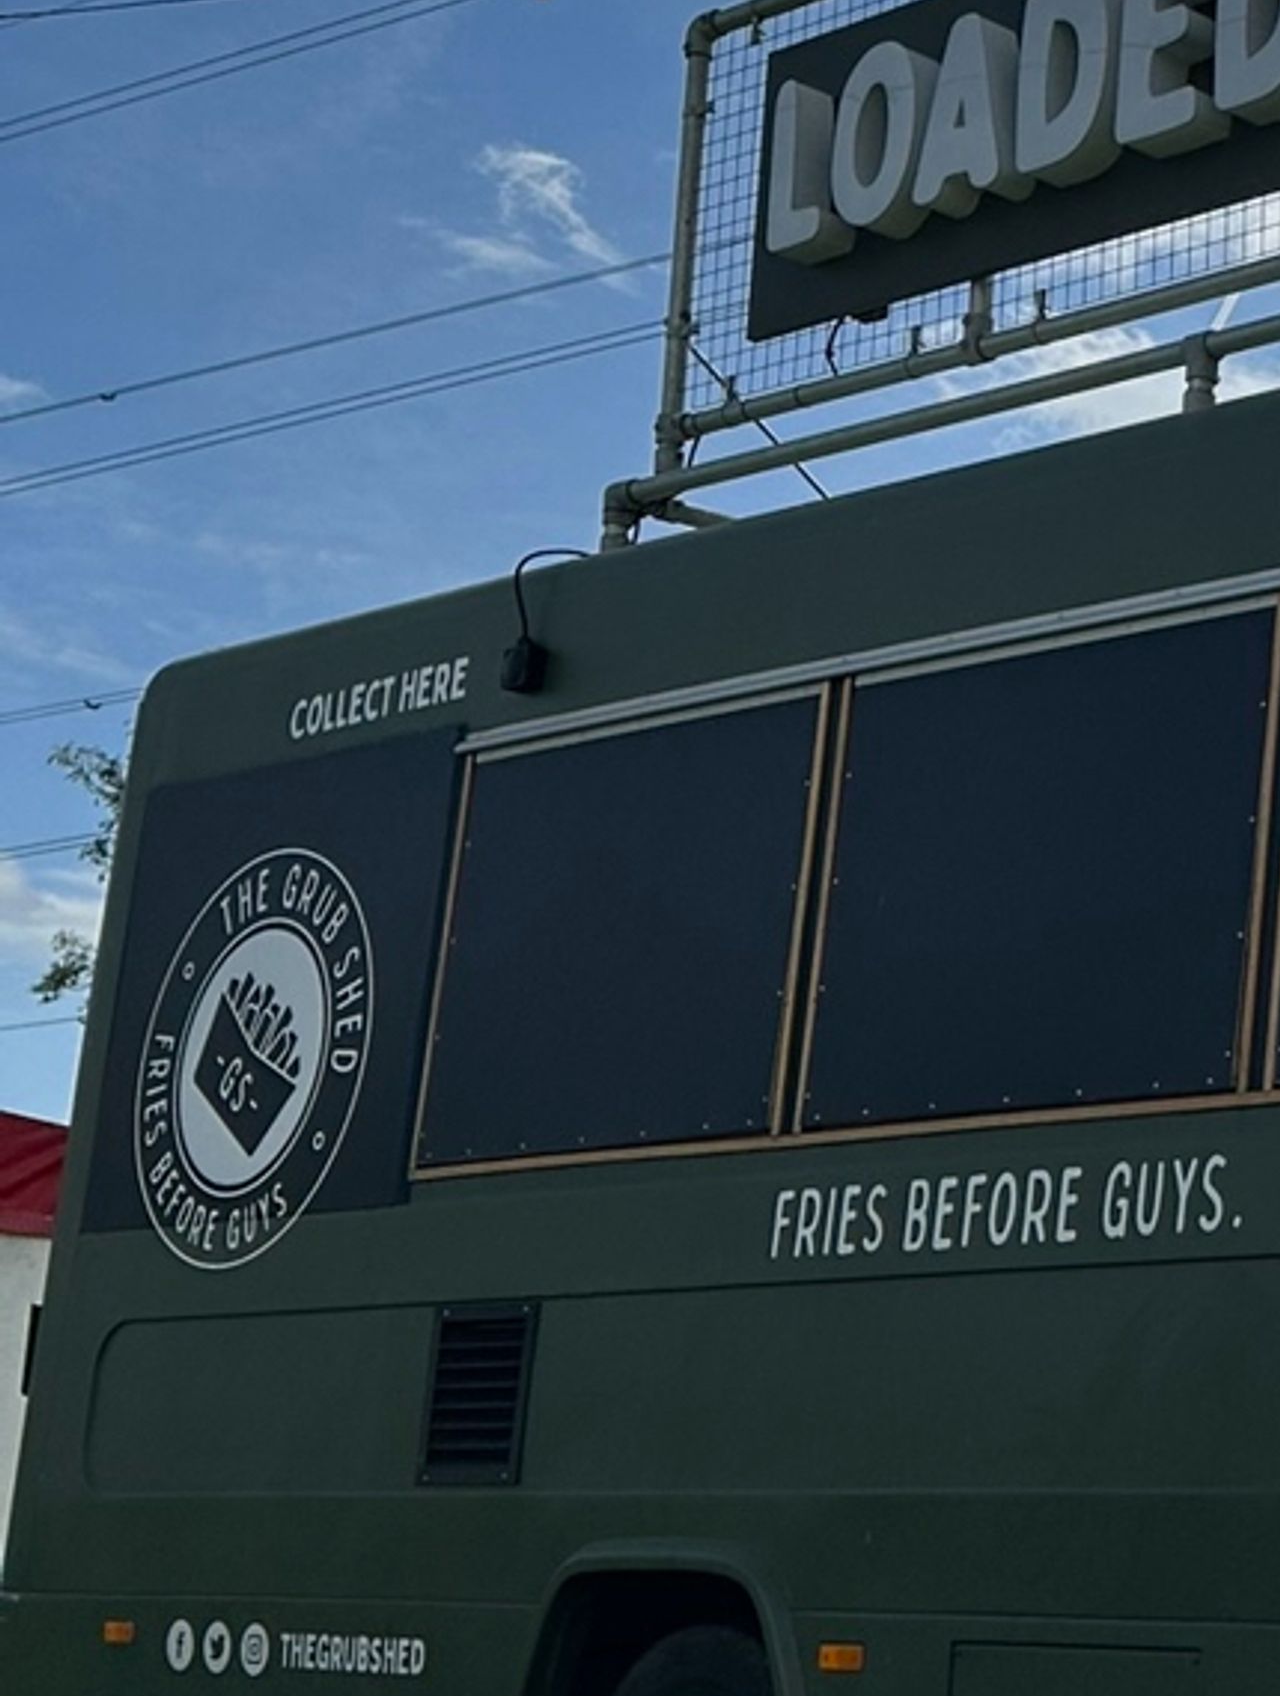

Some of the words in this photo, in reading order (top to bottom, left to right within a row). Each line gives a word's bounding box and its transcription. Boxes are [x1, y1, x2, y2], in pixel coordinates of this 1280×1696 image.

[290, 675, 397, 740] COLLECT
[398, 656, 470, 714] HERE
[219, 868, 270, 935] THE
[282, 863, 350, 944] GRUB
[330, 945, 365, 1074] SHED
[143, 1033, 175, 1147] FRIES
[148, 1151, 216, 1252] BEFORE
[225, 1182, 288, 1251] GUYS
[769, 1184, 888, 1260] FRIES
[902, 1166, 1083, 1252] BEFORE
[1102, 1153, 1244, 1240] GUYS.
[280, 1632, 426, 1676] THEGRUBSHED
